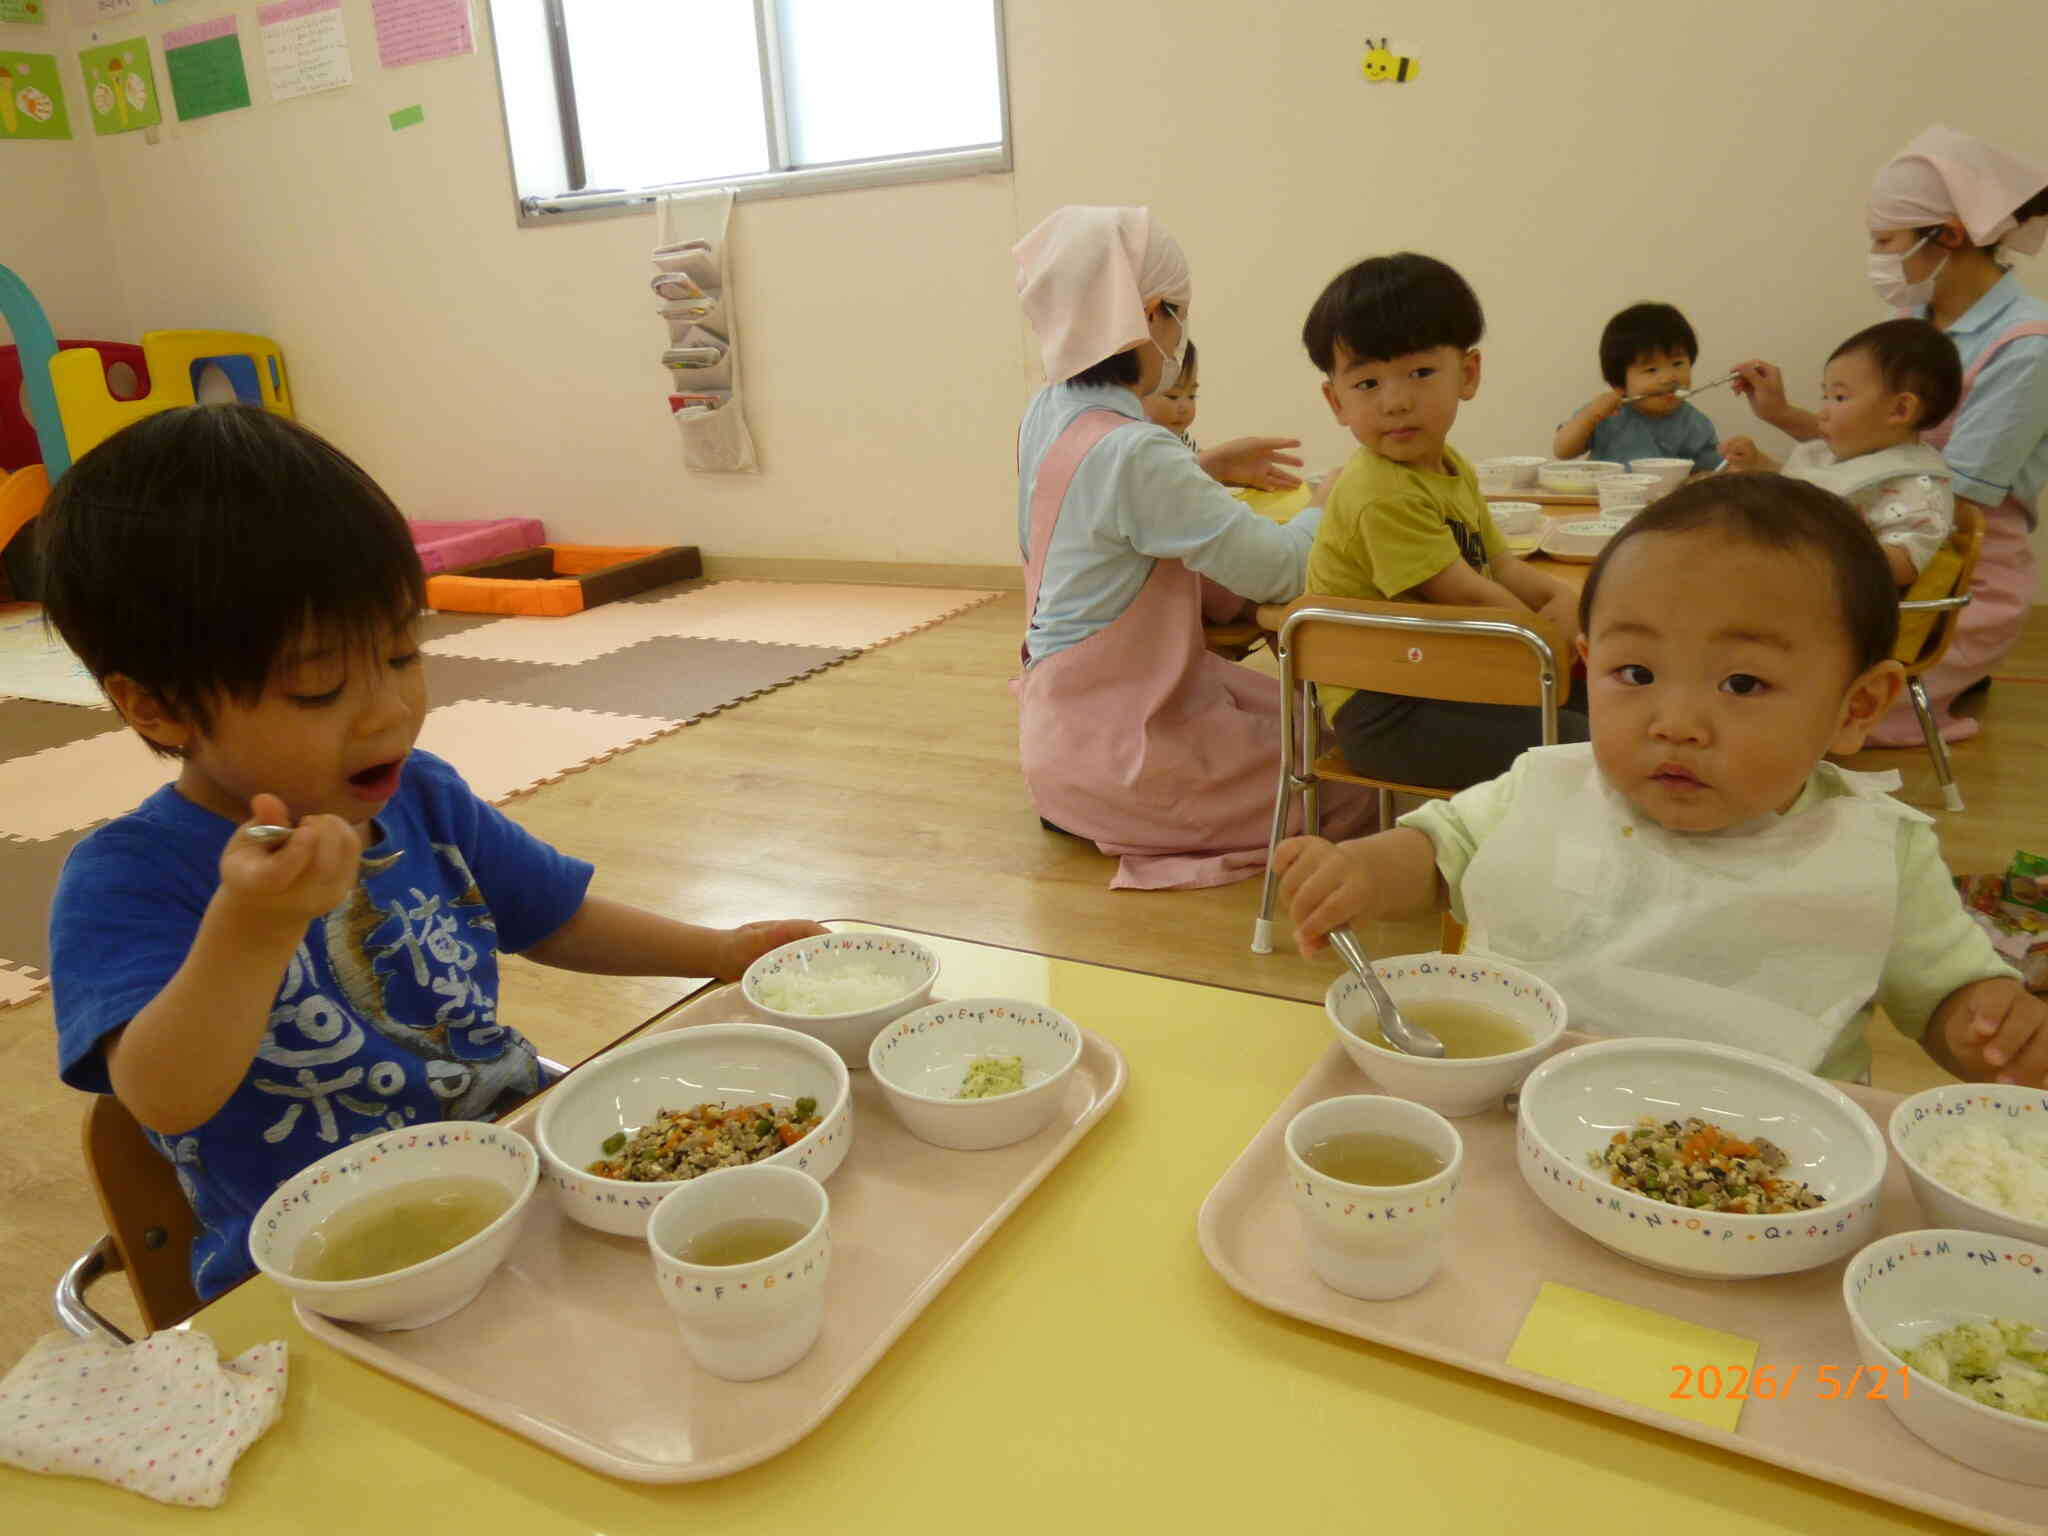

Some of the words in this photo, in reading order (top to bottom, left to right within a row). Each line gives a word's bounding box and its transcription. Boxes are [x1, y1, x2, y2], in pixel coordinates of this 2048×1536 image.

[1420, 963, 1433, 975] Q
[1471, 971, 1480, 983] S
[1764, 1226, 1782, 1240] Q
[1978, 1249, 1998, 1267] N
